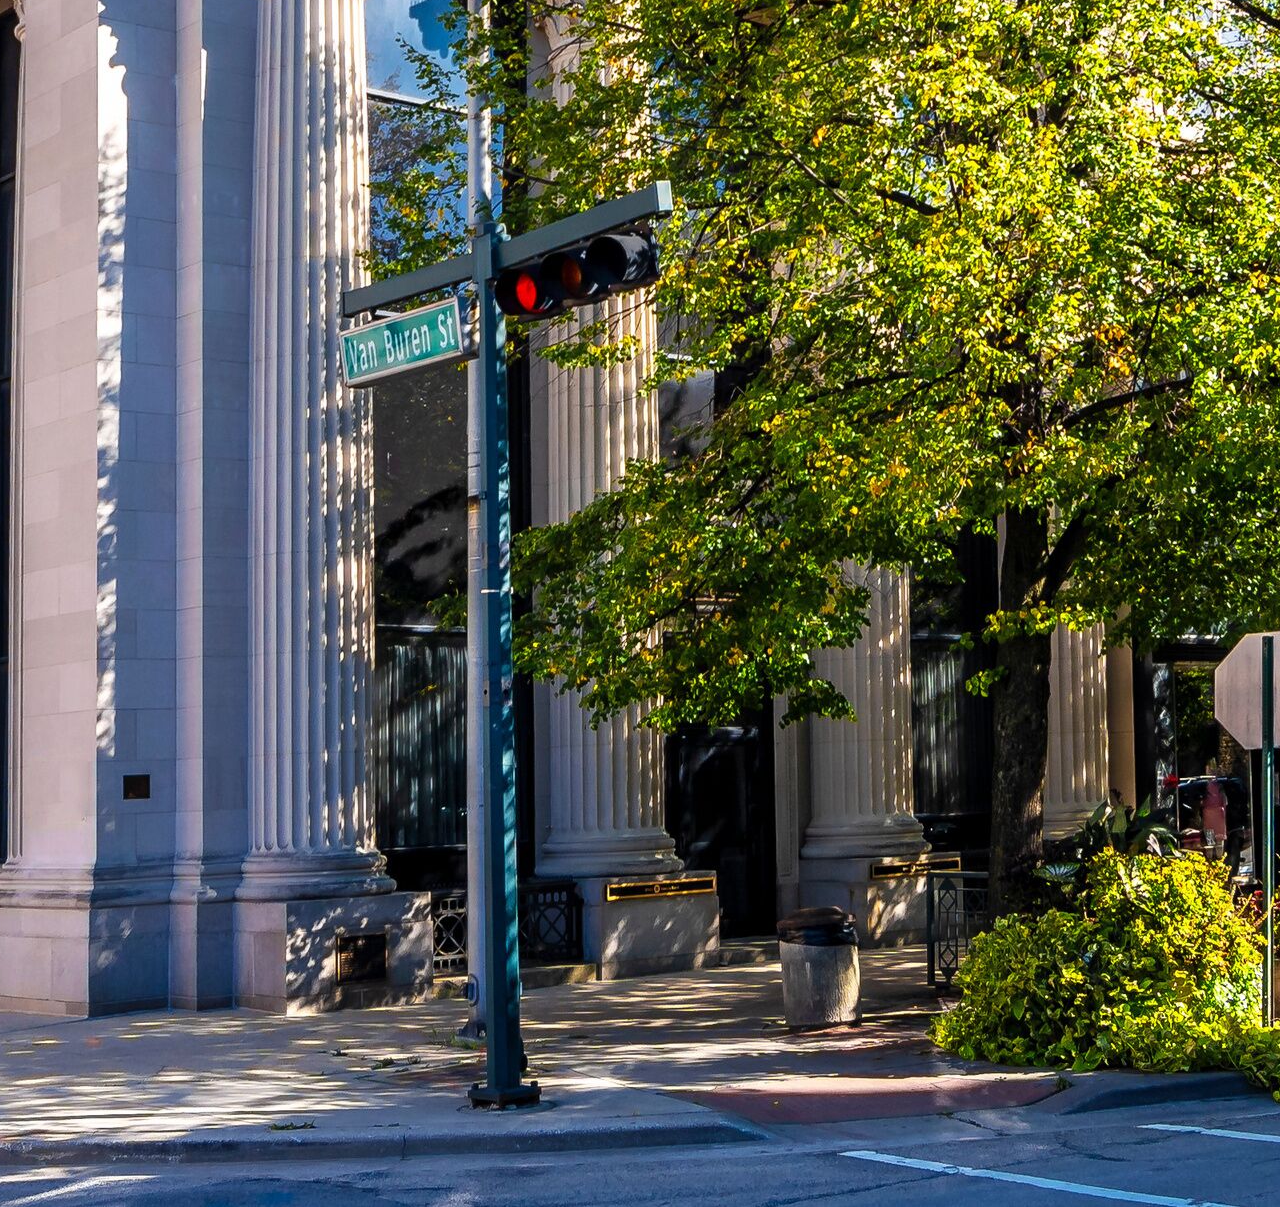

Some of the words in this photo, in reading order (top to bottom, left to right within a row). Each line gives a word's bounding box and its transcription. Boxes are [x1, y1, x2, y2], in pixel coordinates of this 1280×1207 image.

[348, 339, 378, 373] Van
[383, 323, 431, 364] Buren
[437, 310, 455, 349] St
